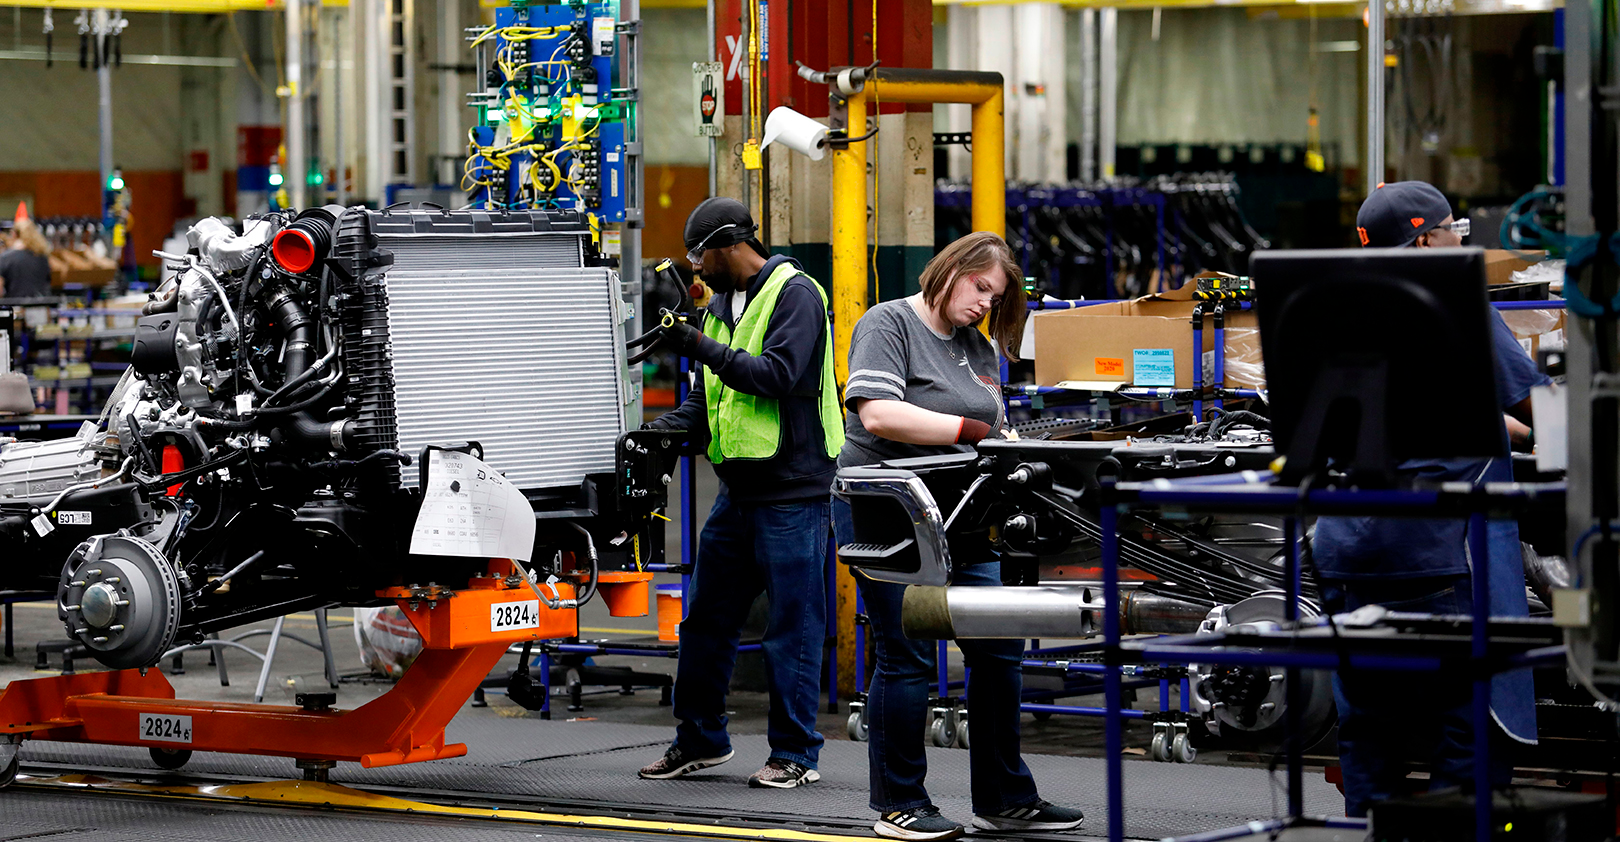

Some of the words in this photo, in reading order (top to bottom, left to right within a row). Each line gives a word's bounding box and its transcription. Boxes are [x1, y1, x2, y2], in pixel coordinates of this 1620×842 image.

[702, 101, 715, 111] STOP
[699, 126, 720, 136] BUTTON
[60, 514, 75, 523] LC5
[496, 604, 530, 627] 2824
[145, 717, 182, 738] 2824
